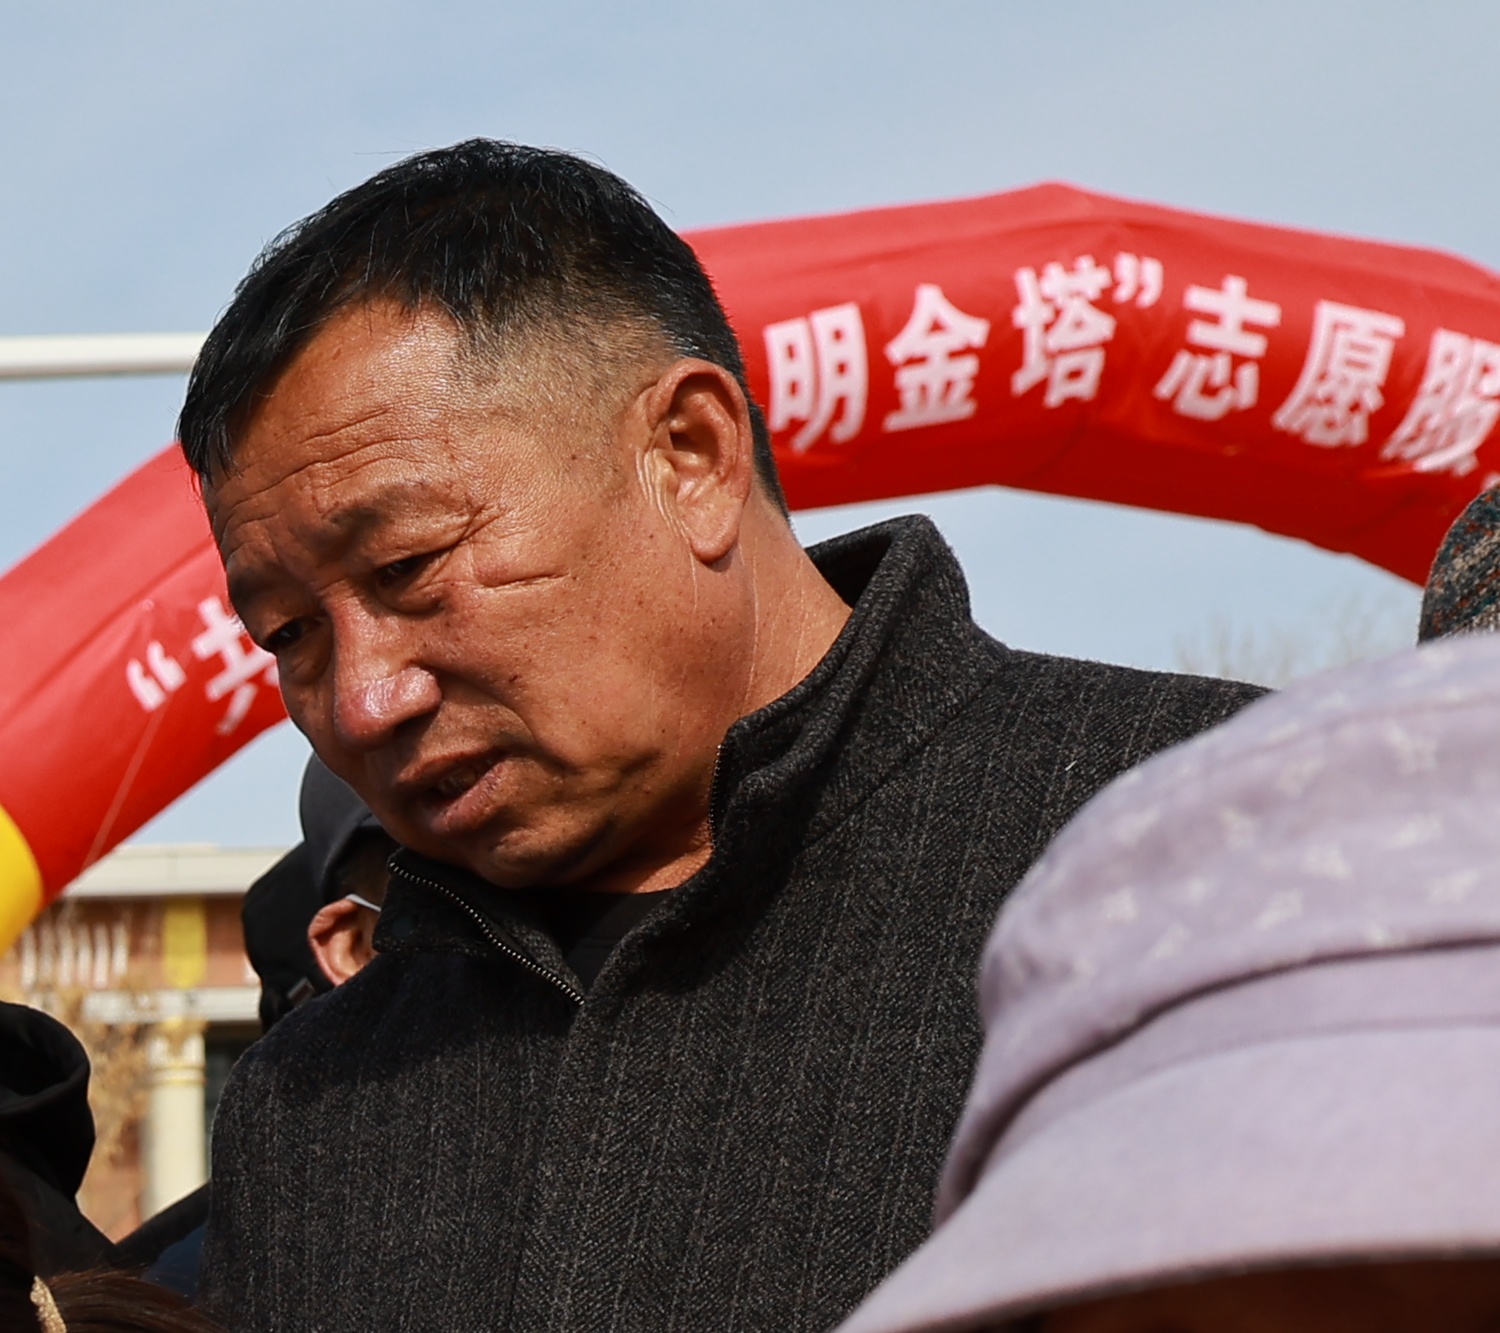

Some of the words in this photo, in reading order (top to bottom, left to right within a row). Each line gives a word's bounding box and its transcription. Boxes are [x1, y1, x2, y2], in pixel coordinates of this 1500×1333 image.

[762, 251, 1500, 490] 明金塔”志愿服
